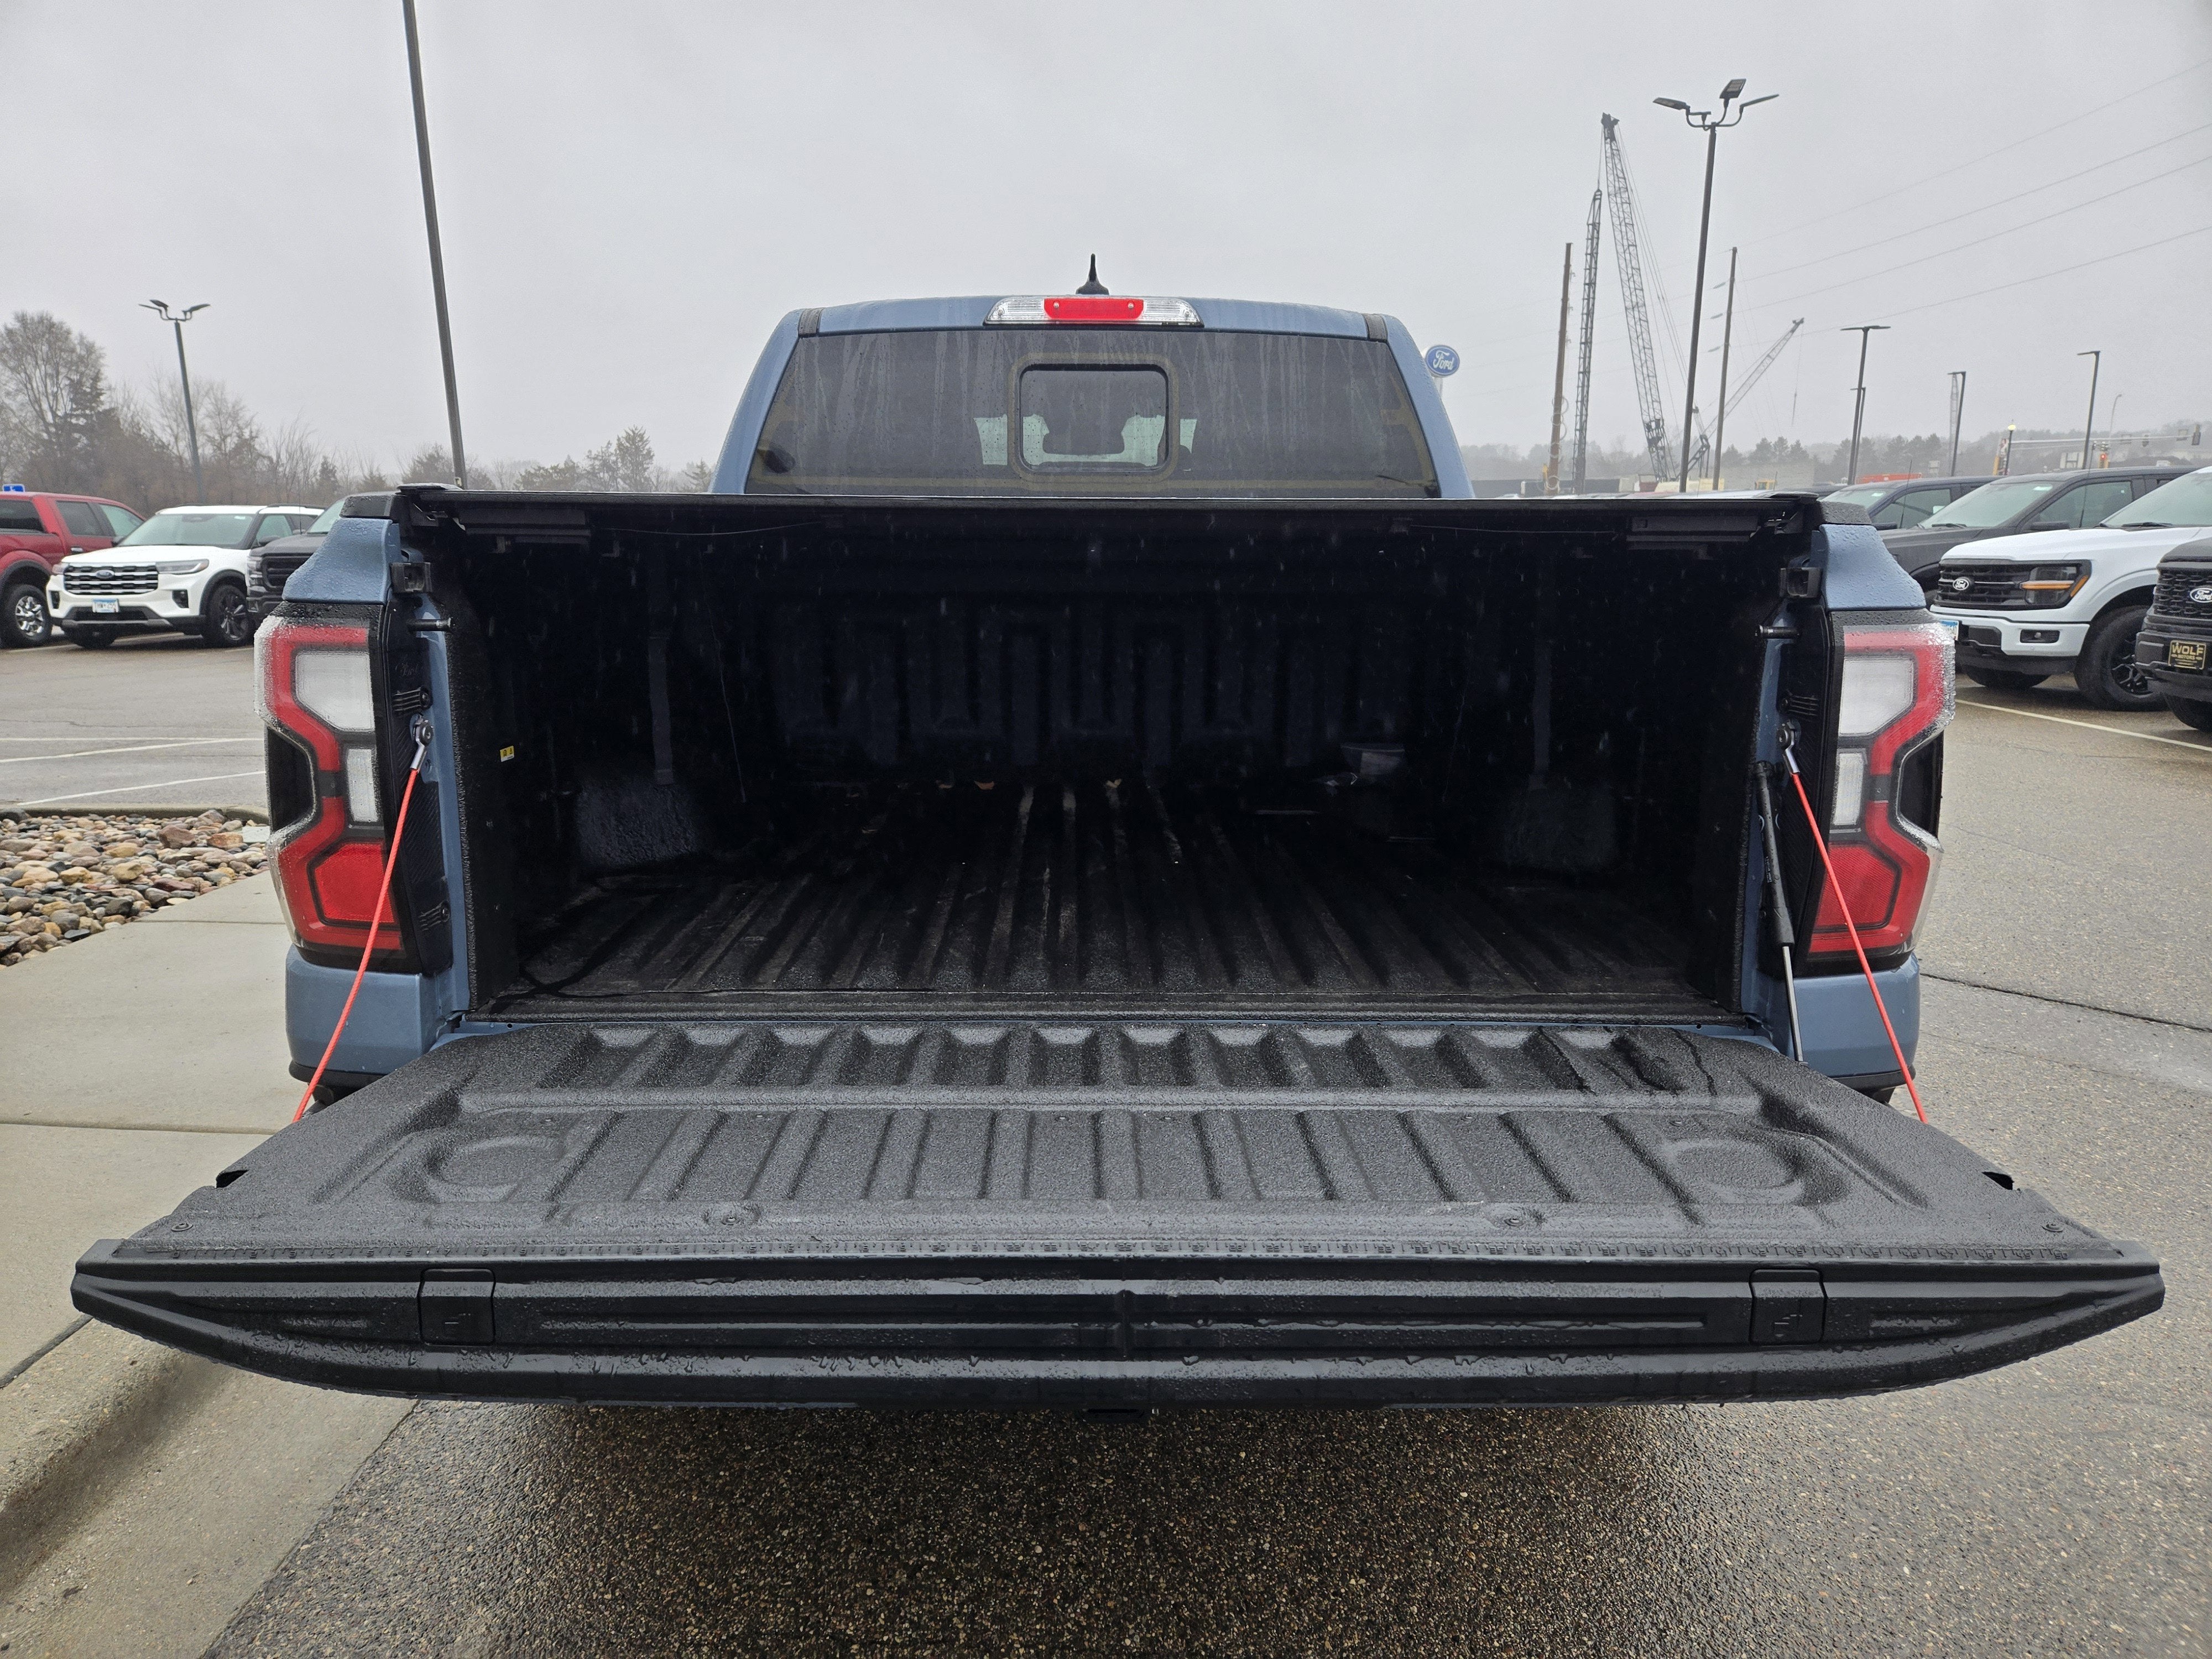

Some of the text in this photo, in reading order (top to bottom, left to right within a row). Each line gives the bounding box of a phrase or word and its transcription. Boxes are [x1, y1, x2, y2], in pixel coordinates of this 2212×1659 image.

[1433, 350, 1454, 371] Ford
[2194, 589, 2212, 600] Ford
[2172, 644, 2204, 655] WOLF
